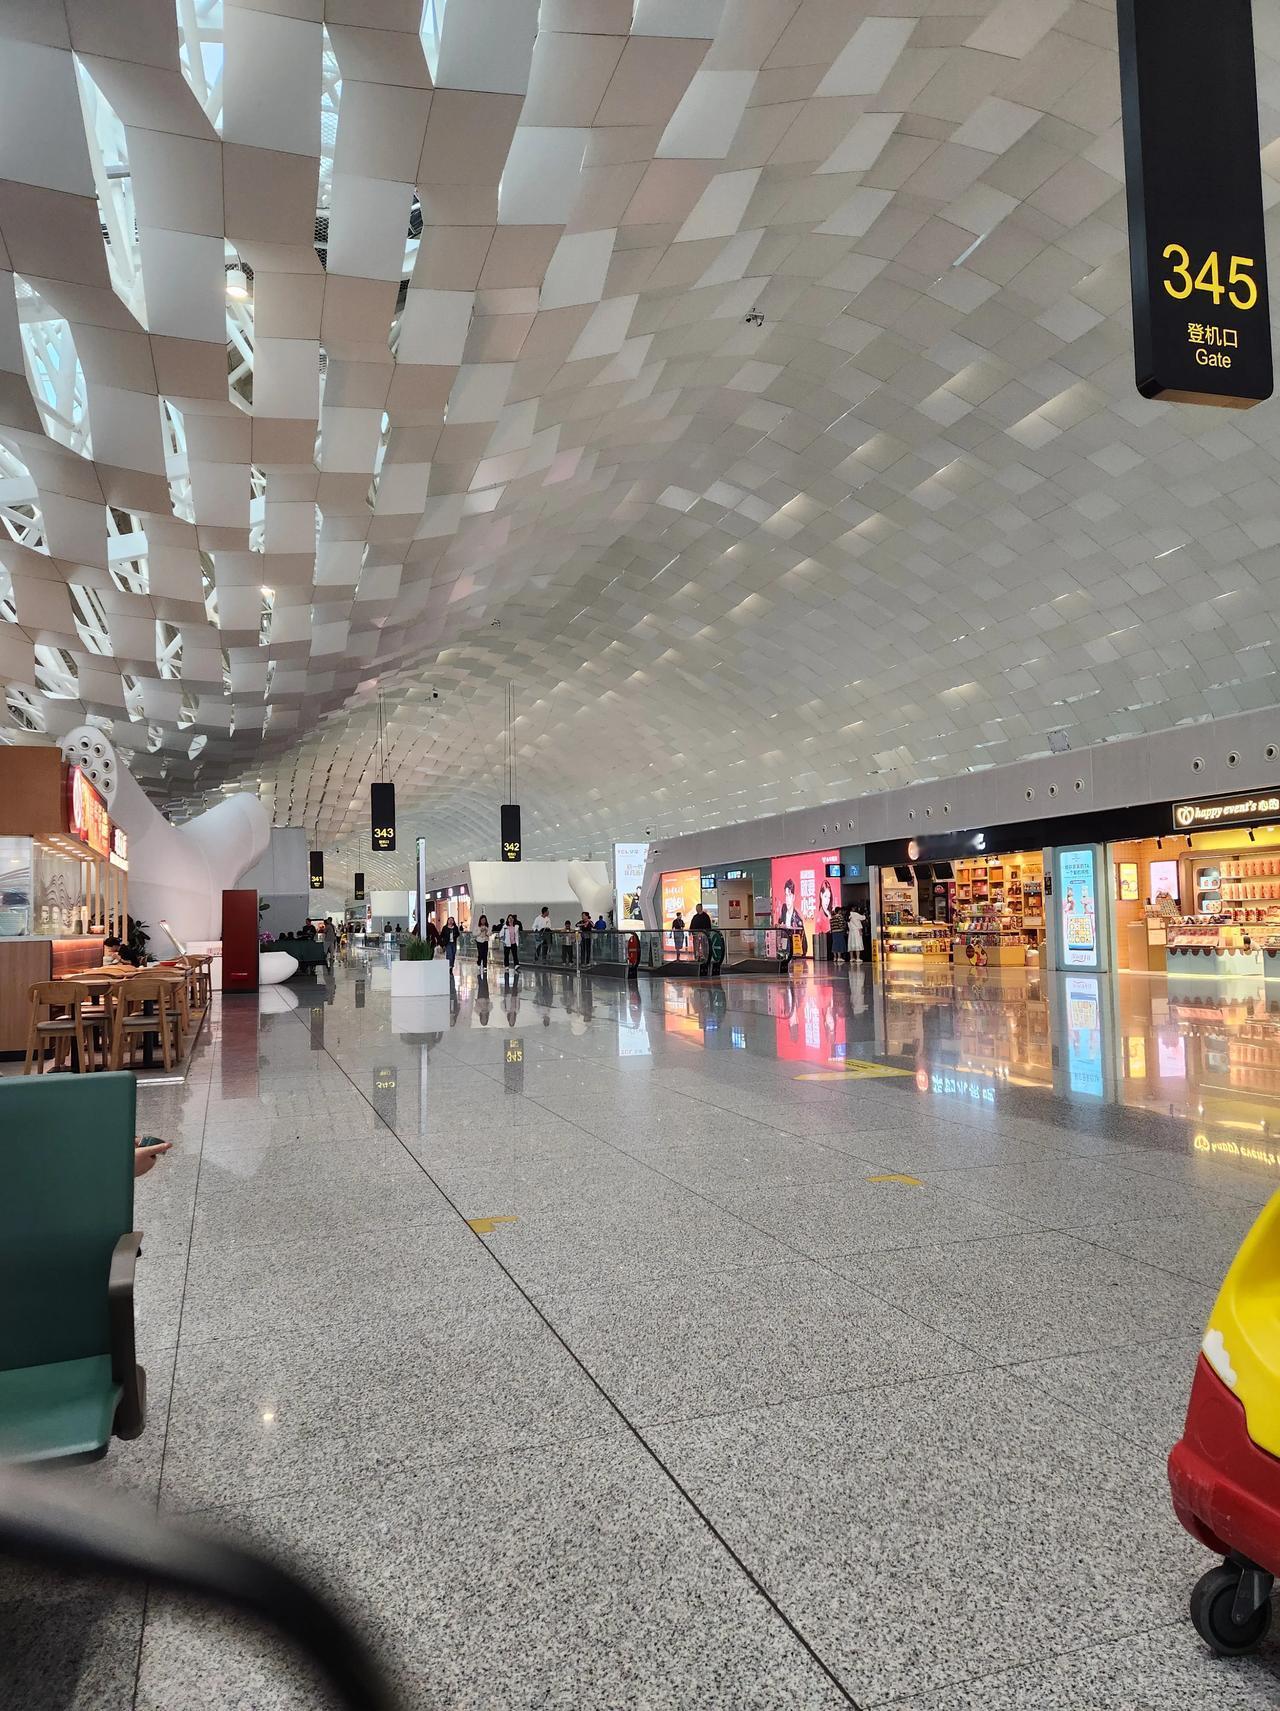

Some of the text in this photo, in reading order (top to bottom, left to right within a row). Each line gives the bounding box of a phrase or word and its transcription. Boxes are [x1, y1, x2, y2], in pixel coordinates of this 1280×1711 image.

[1162, 243, 1258, 310] 345
[1187, 322, 1238, 348] 登机口
[1195, 348, 1232, 369] Gate
[1195, 807, 1223, 819] happy
[1223, 800, 1257, 815] event's
[374, 828, 394, 838] 343
[504, 842, 520, 851] 342
